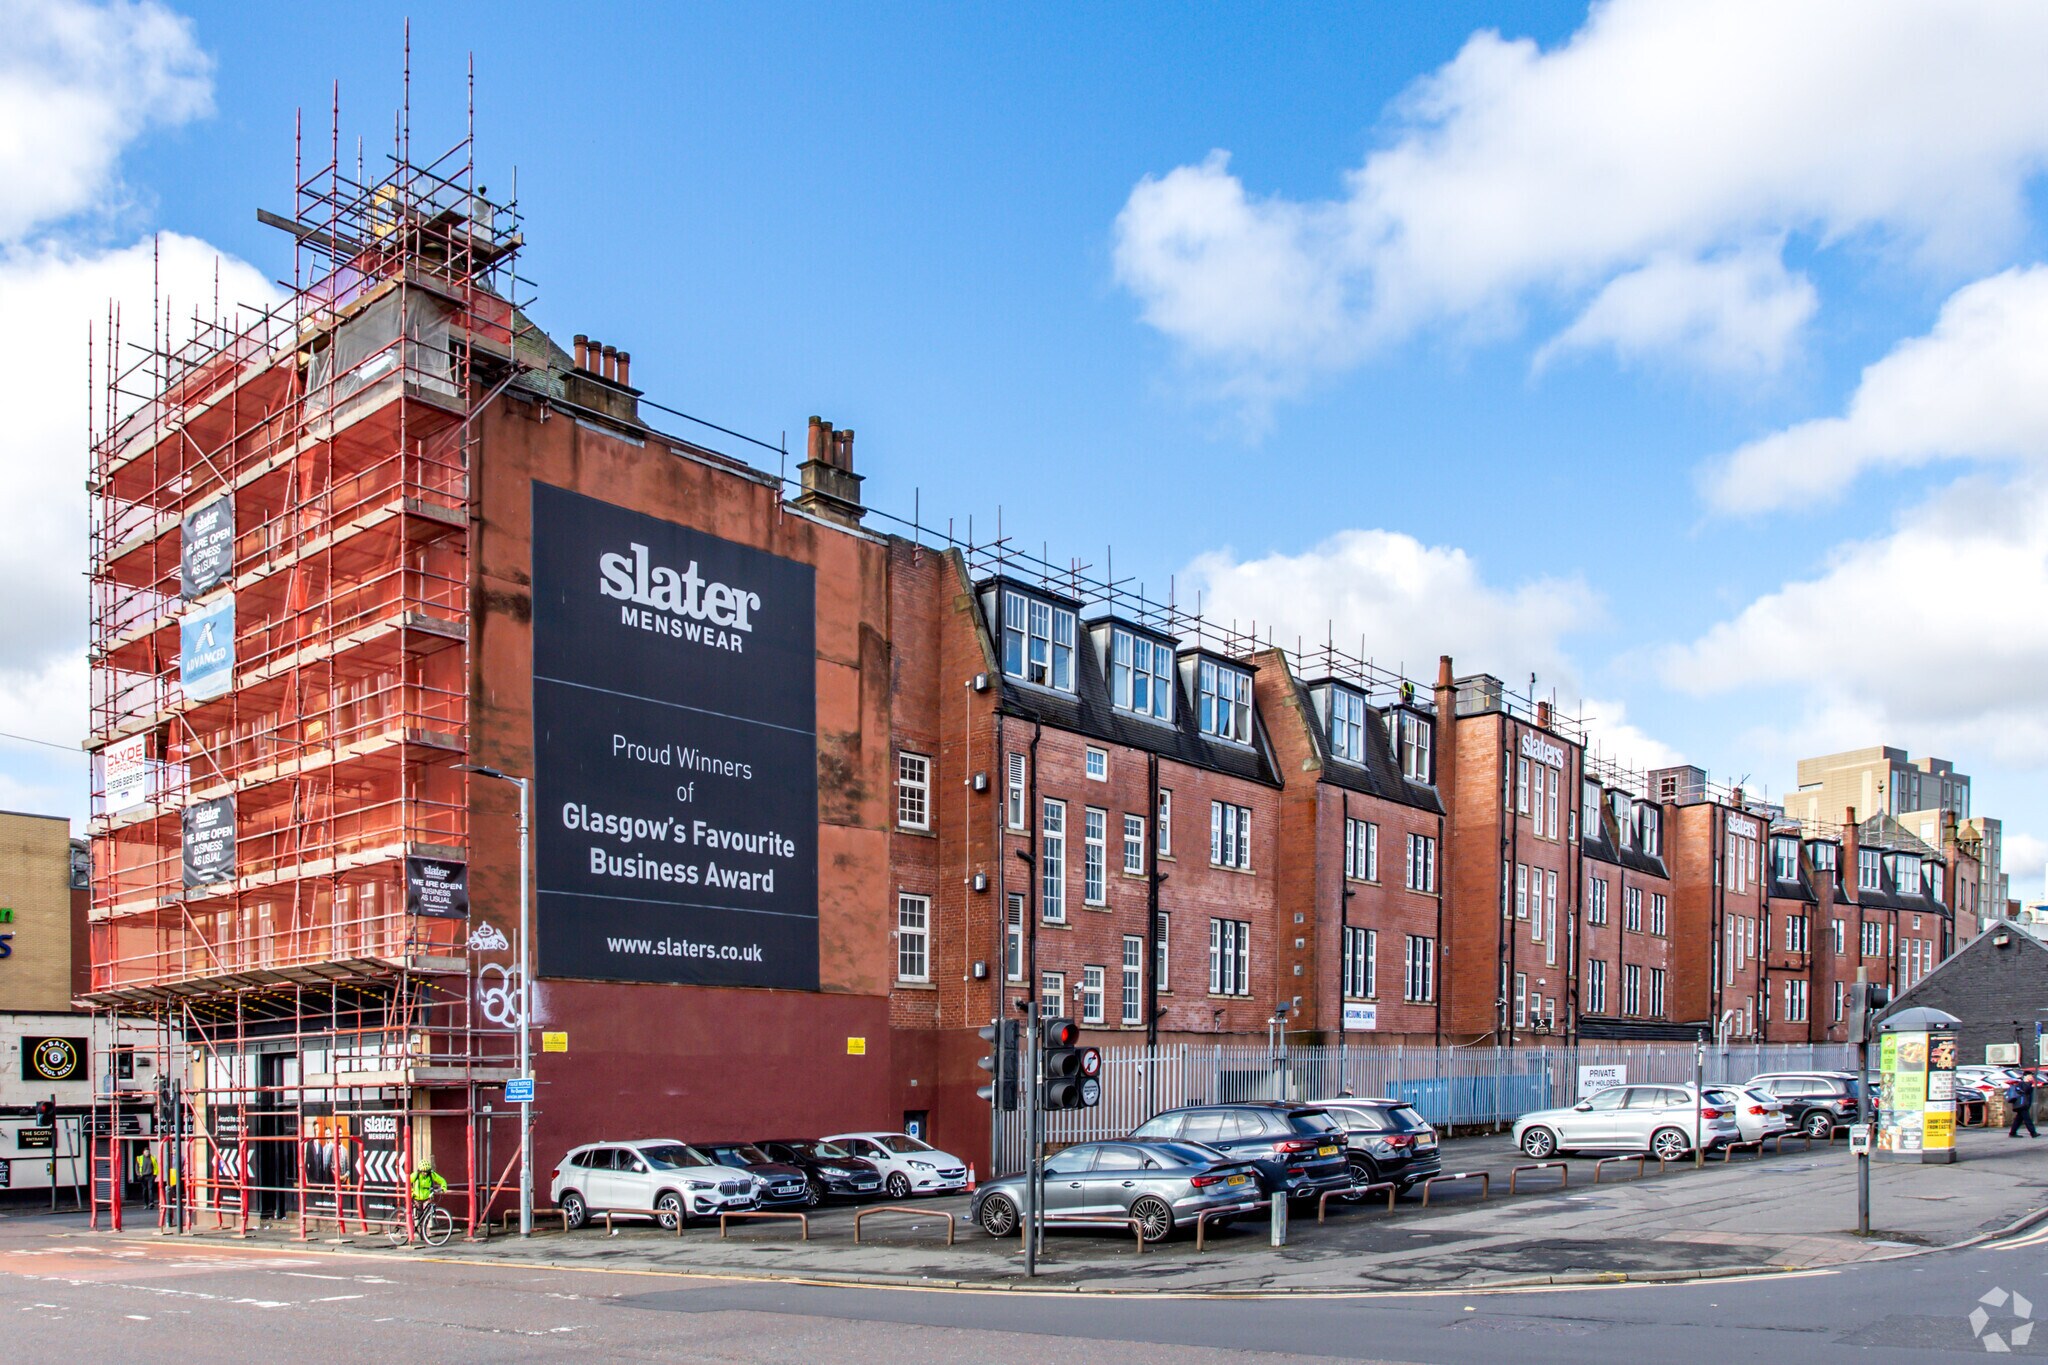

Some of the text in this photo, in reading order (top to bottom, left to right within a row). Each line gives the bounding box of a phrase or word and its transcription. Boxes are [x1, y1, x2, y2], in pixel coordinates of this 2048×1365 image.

[194, 536, 208, 551] ARE
[210, 527, 230, 544] OPEN
[192, 566, 200, 576] AS
[599, 542, 761, 633] slater
[621, 605, 743, 653] MENSWEAR
[186, 647, 226, 672] ADVANCED
[108, 744, 142, 767] CLYDE
[613, 734, 752, 780] Proud Winners
[1522, 729, 1564, 769] slaters
[676, 781, 694, 803] of
[196, 806, 220, 823] slater
[1728, 811, 1757, 839] slaters
[196, 831, 210, 842] ARE
[211, 826, 233, 839] OPEN
[562, 802, 795, 858] Glasgow's Favourite
[193, 855, 202, 866] AS
[424, 865, 450, 877] slater
[590, 847, 774, 893] Business Award
[421, 887, 451, 897] BUSINESS
[430, 895, 452, 904] USUAL
[606, 937, 763, 962] www.slaters.co.uk
[40, 1064, 72, 1076] POOL HALL
[1590, 1069, 1615, 1077] PRIVATE
